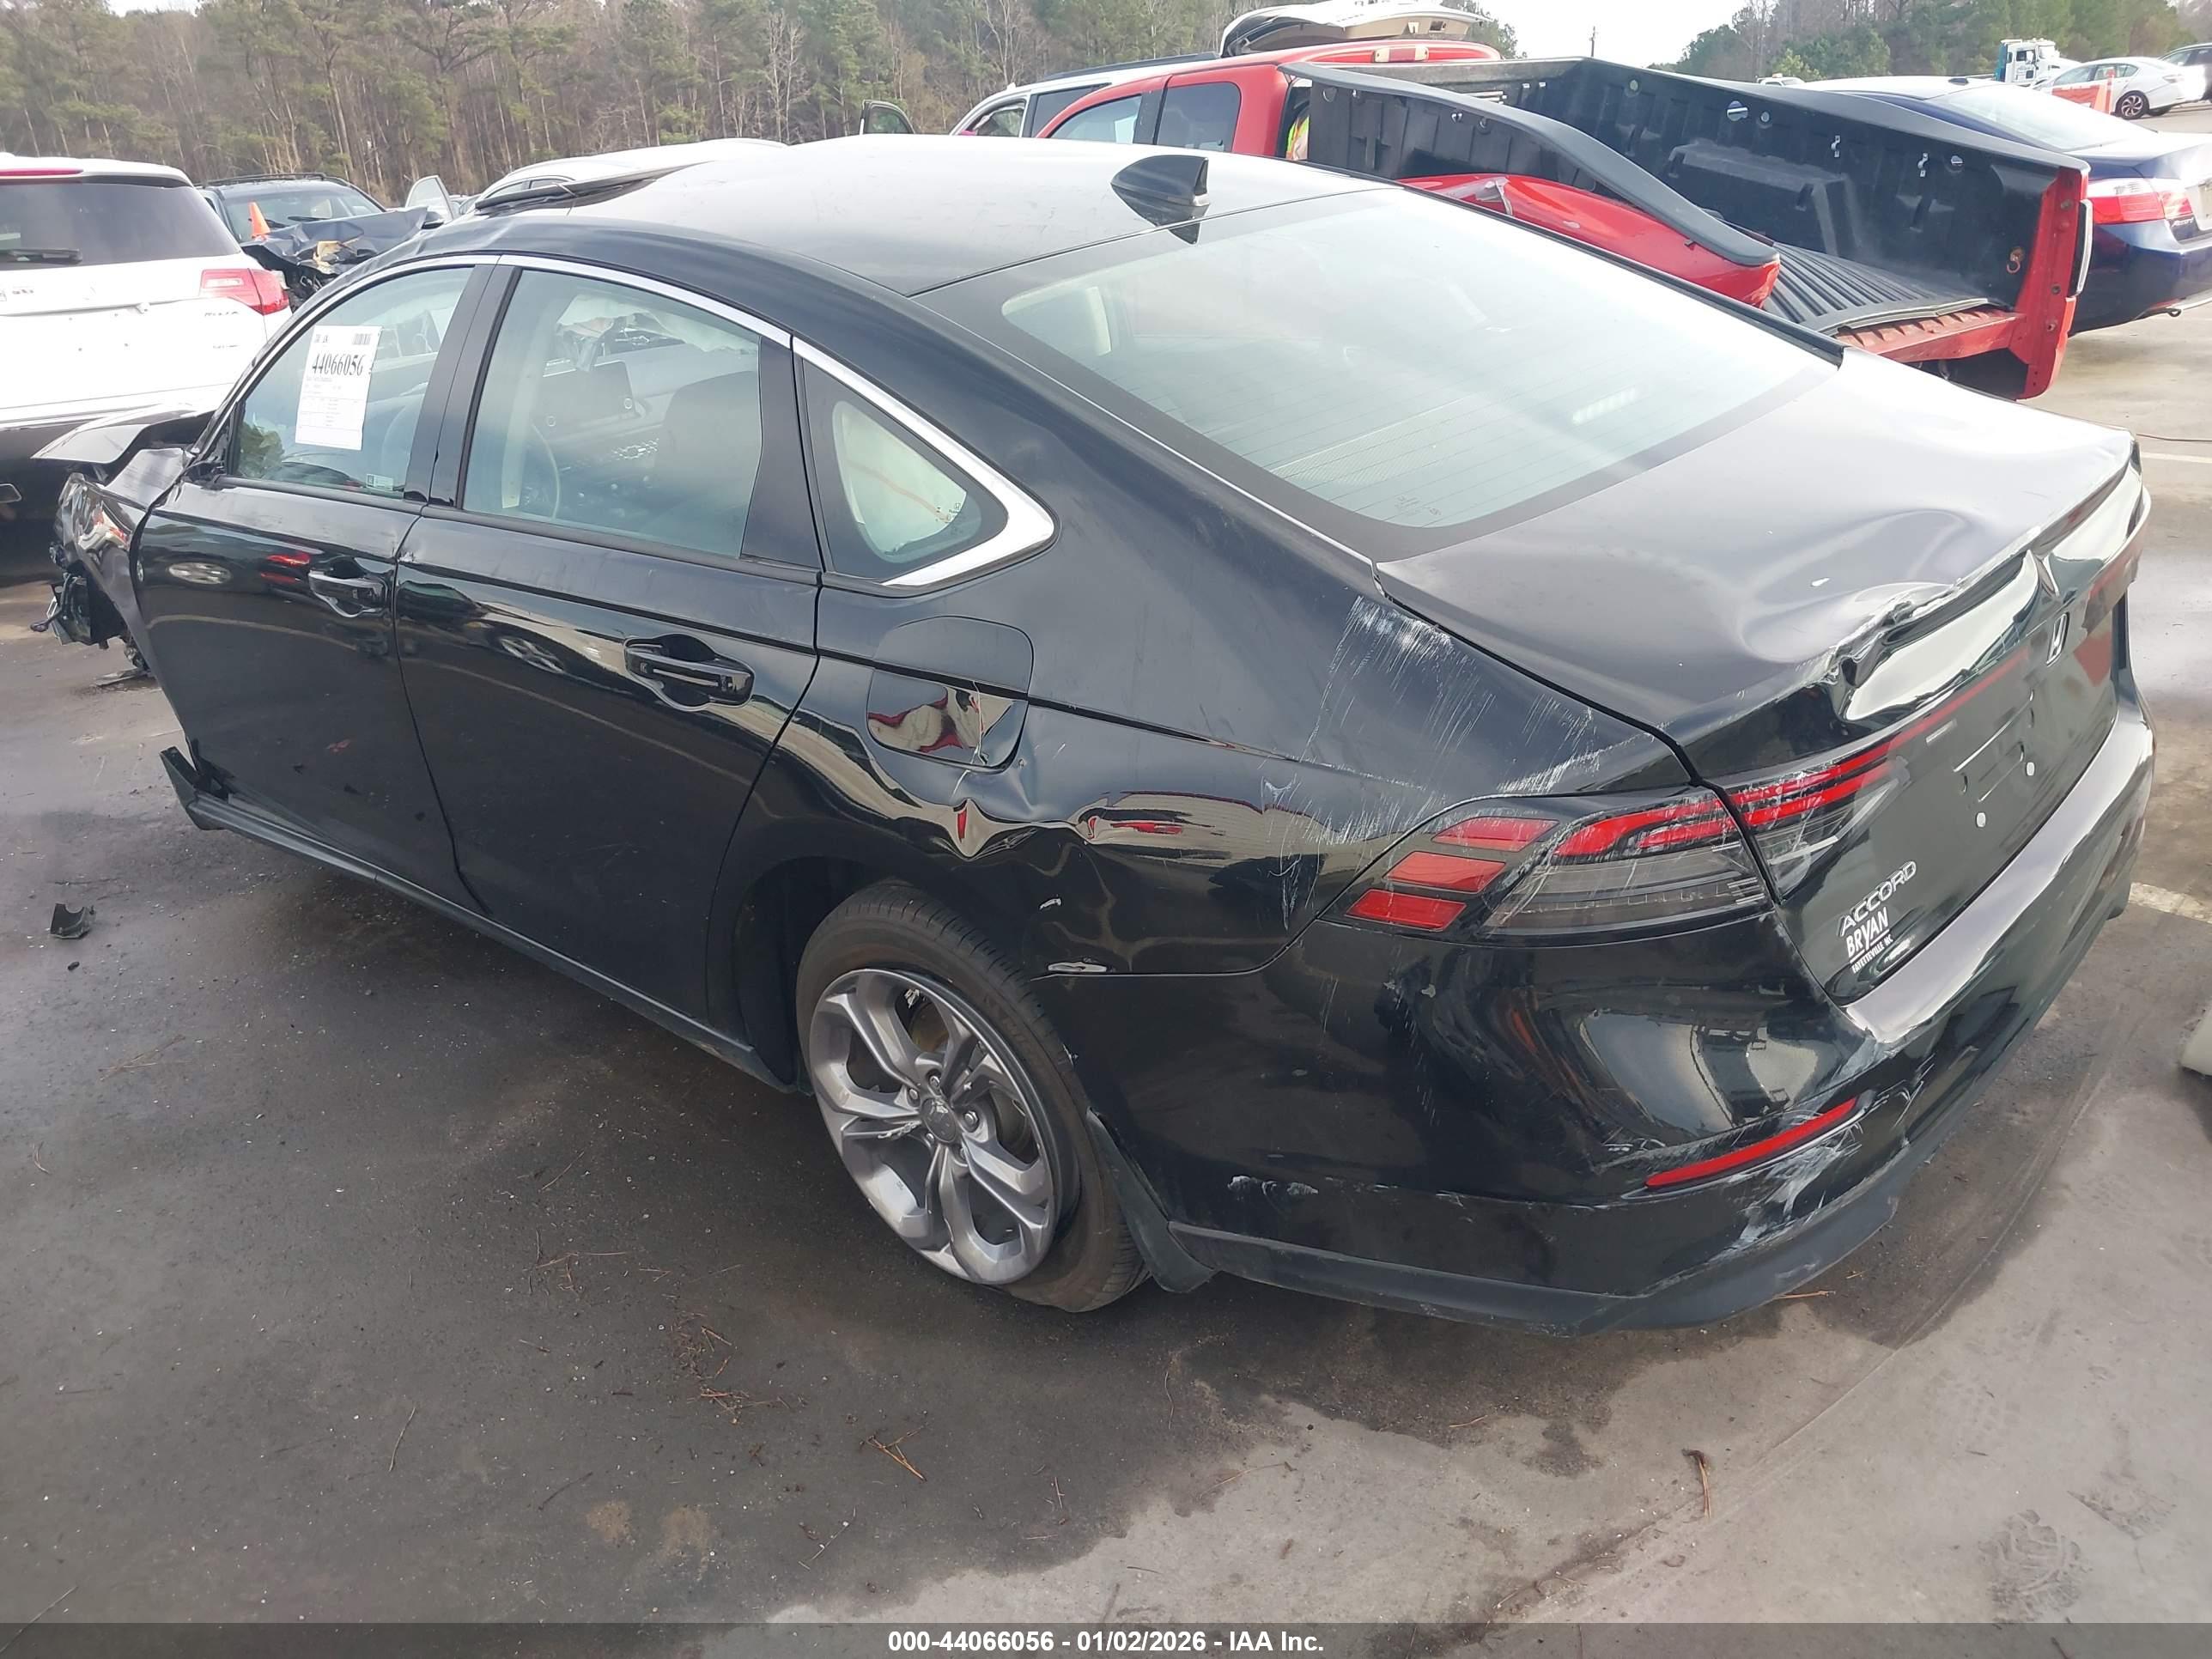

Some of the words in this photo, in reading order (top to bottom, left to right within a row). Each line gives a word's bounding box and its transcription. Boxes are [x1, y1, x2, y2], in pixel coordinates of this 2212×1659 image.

[312, 353, 366, 376] 44066056
[1839, 860, 1917, 938] ACCORD
[1845, 906, 1889, 958] BRYAN
[1851, 941, 1885, 974] FAYETTEVILLE
[1883, 933, 1894, 946] NC
